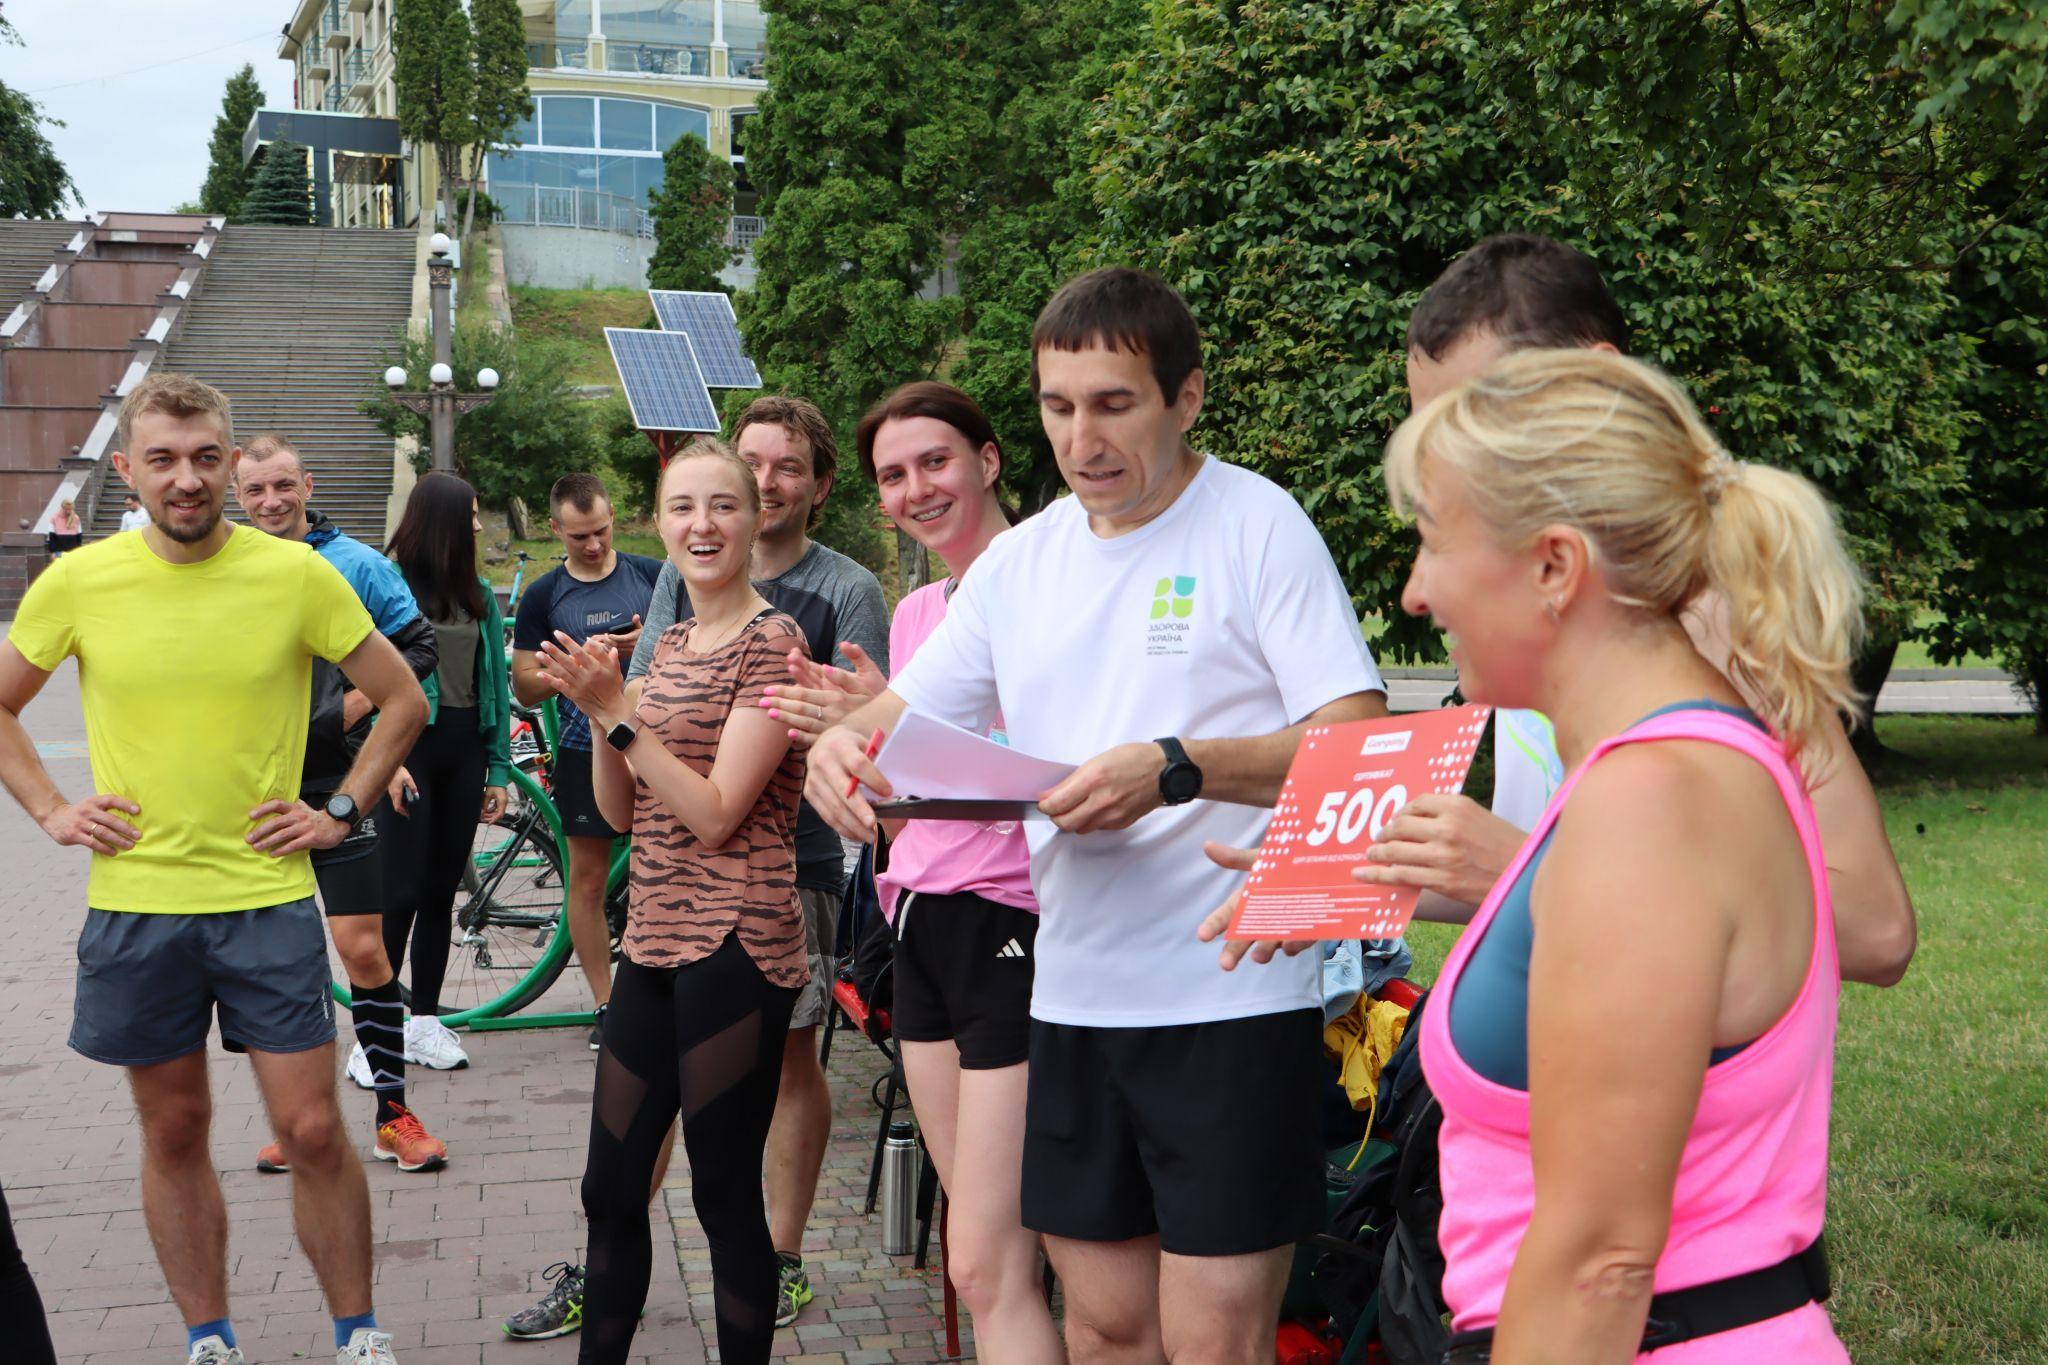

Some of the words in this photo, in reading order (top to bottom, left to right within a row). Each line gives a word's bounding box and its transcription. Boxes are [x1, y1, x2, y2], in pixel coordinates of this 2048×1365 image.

[587, 611, 610, 626] RUN
[1148, 623, 1190, 632] ЗДОРОВА
[1147, 633, 1183, 642] УКРАЇНА
[1305, 784, 1408, 846] 500
